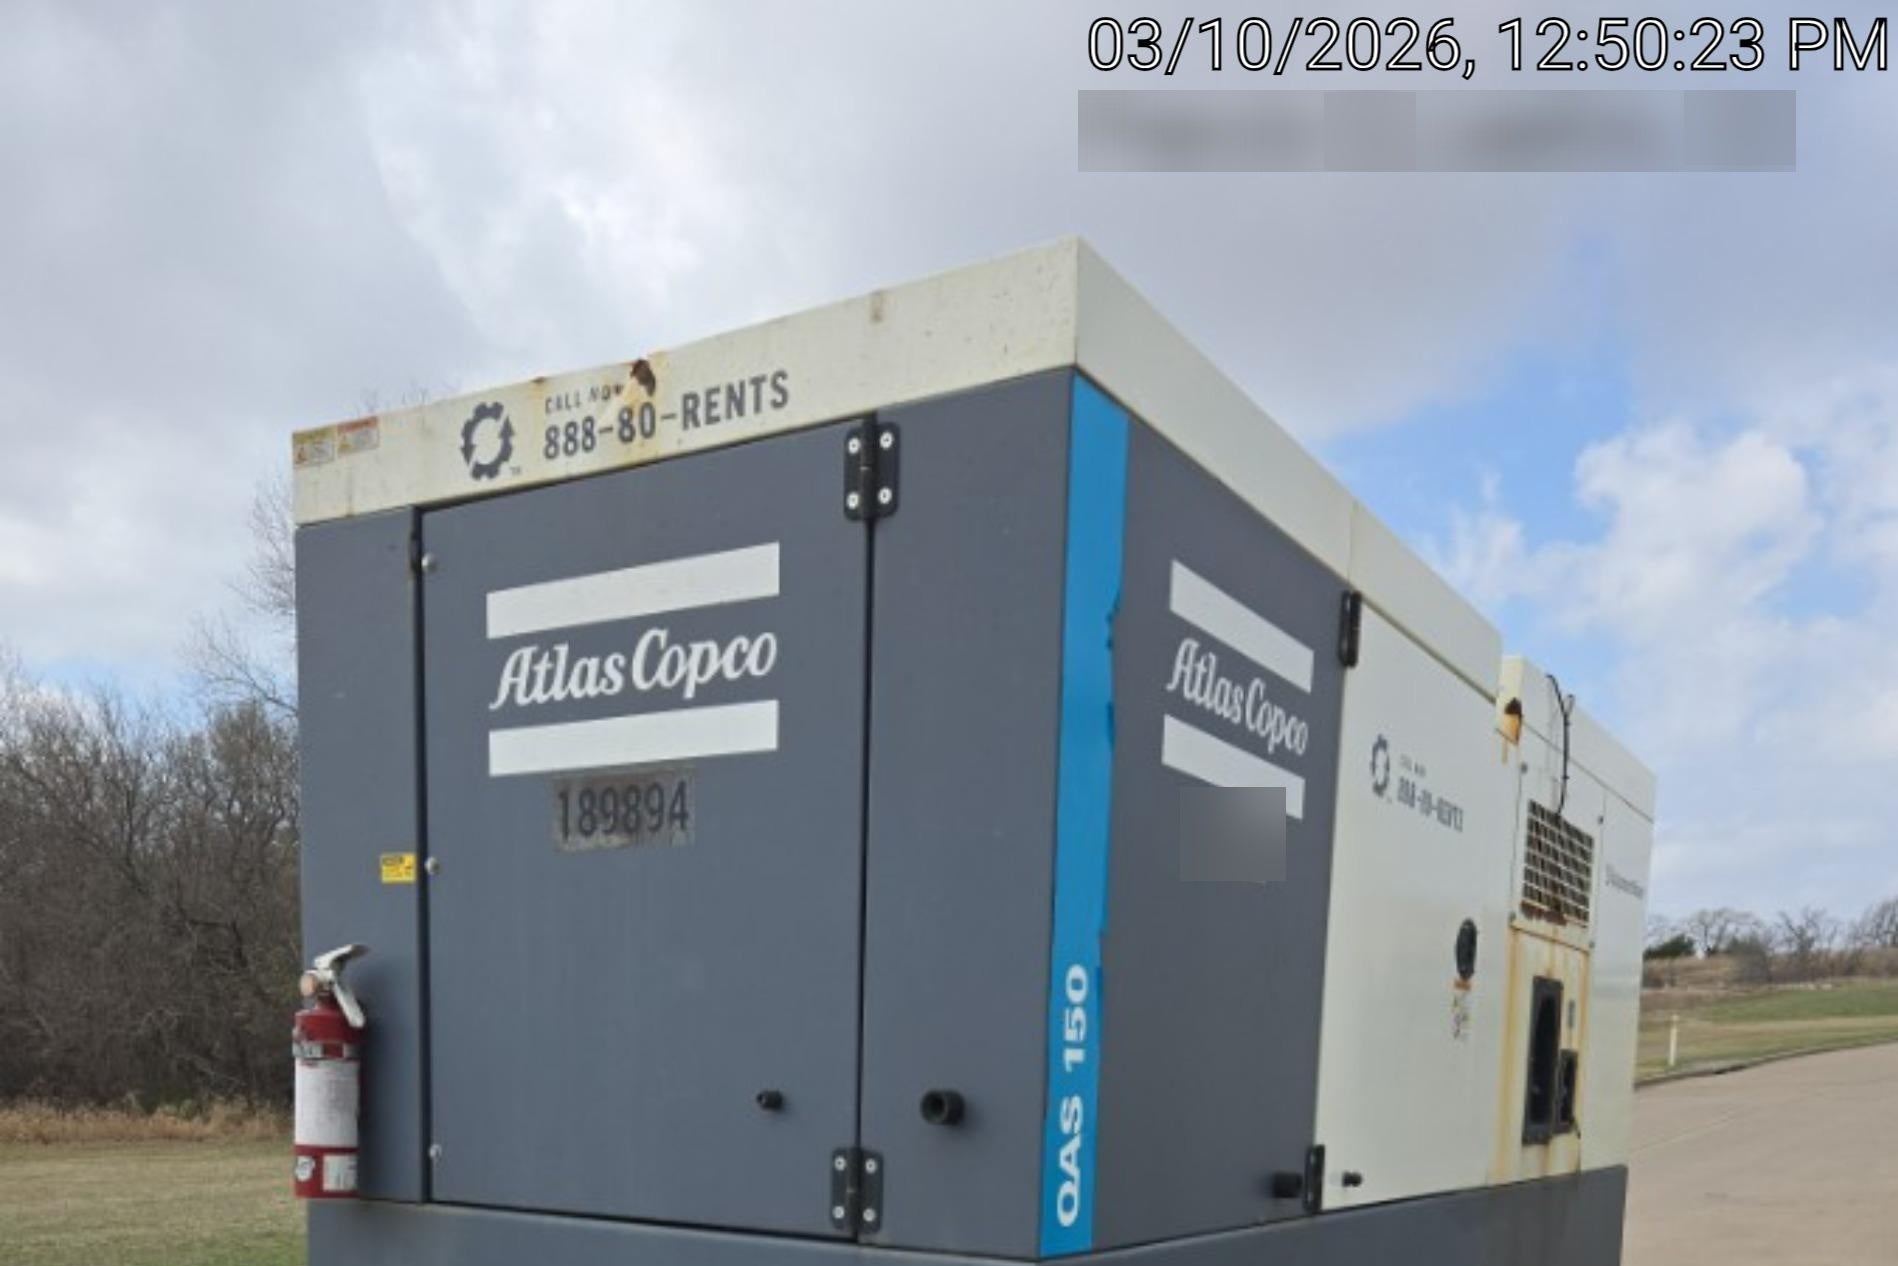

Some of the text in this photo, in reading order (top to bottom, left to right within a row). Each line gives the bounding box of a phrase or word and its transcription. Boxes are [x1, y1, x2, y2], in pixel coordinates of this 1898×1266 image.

[543, 369, 790, 460] 888-80-RENTS
[545, 394, 581, 415] CALL
[557, 779, 690, 842] 189894
[1062, 963, 1089, 1073] 150
